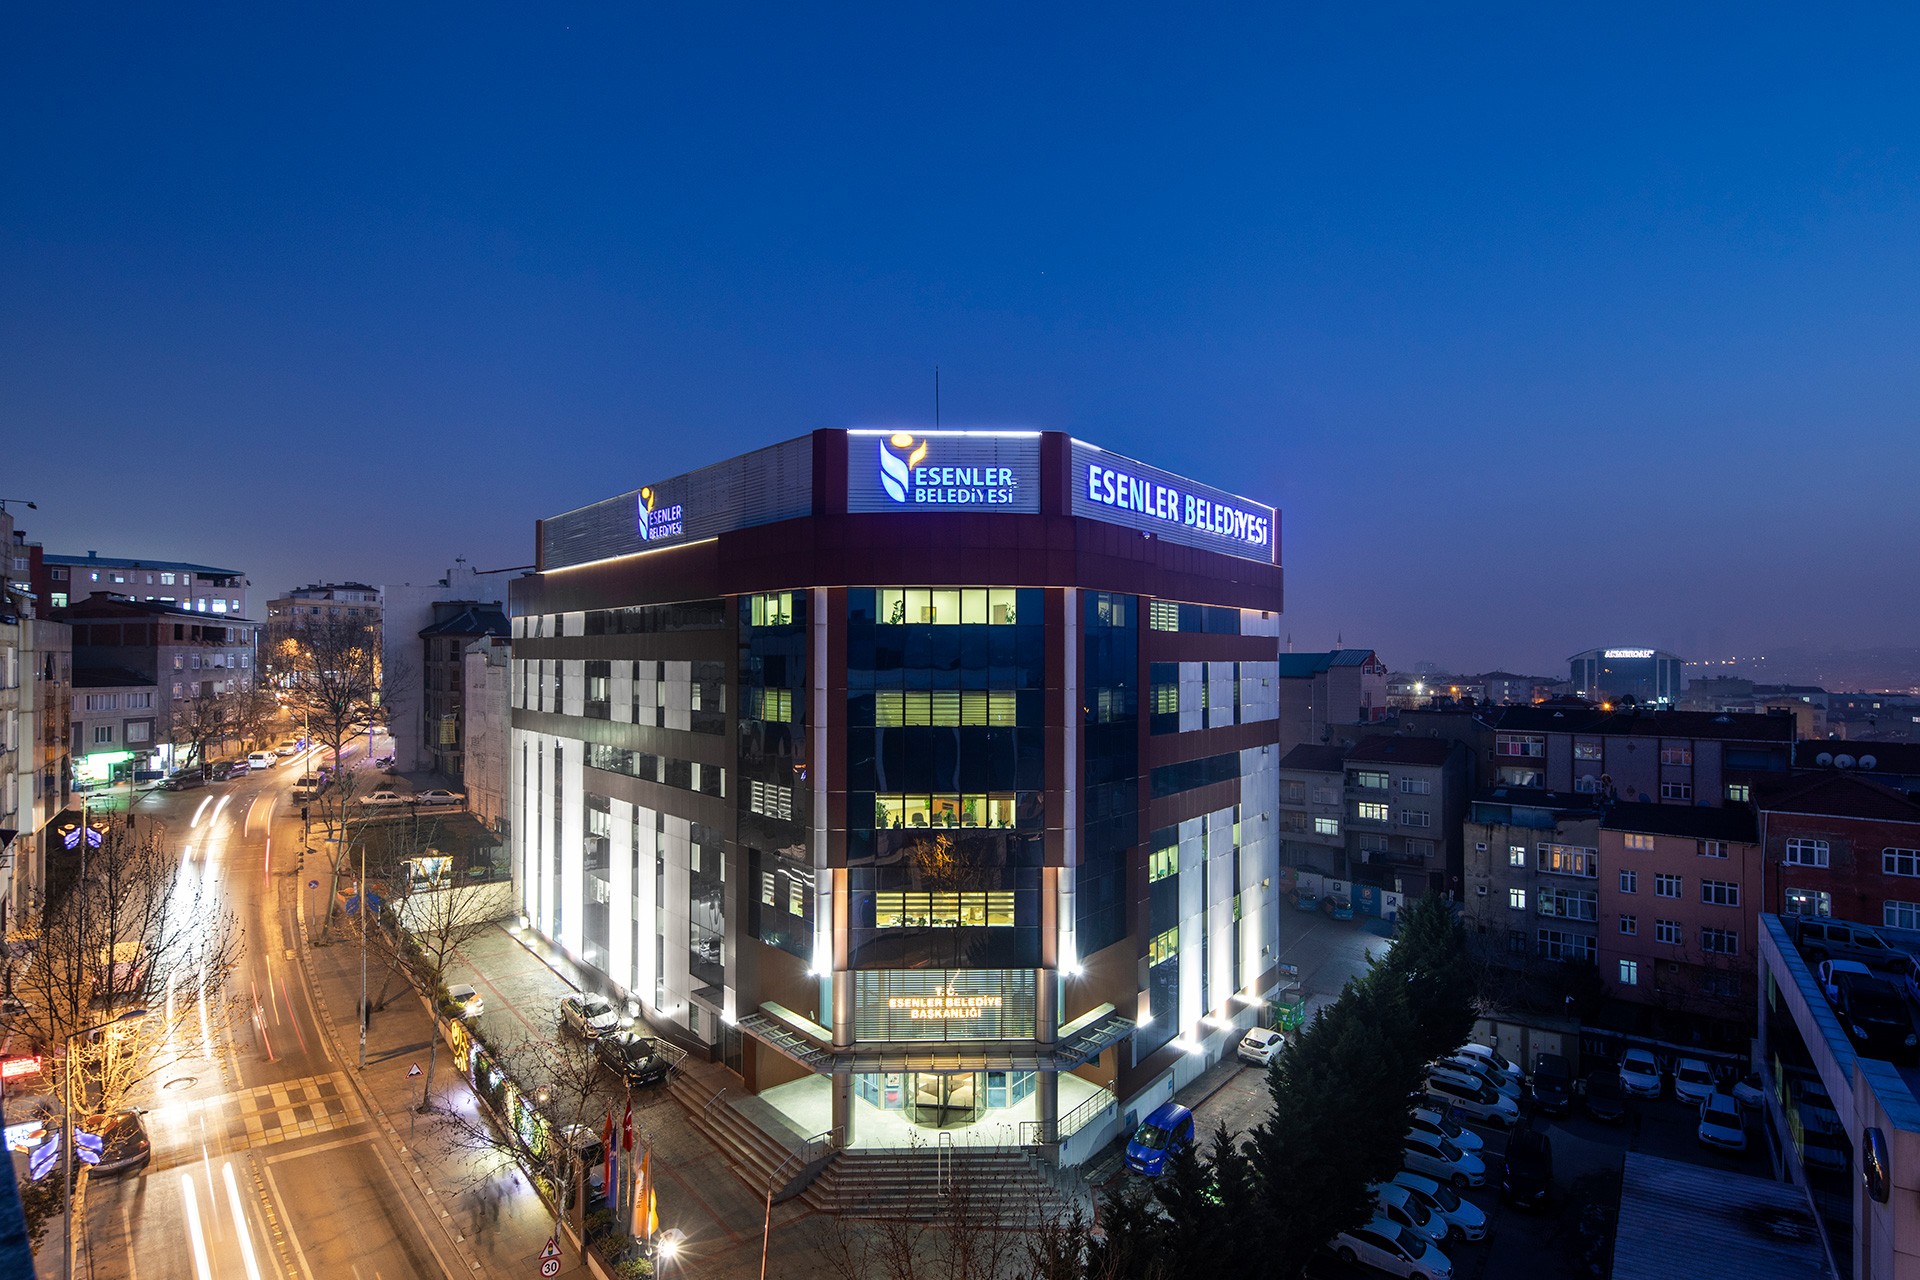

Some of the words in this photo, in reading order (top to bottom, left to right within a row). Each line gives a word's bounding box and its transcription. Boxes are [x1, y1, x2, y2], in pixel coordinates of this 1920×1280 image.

[915, 467, 1013, 486] ESENLER
[1089, 464, 1179, 522] ESENLER
[649, 504, 682, 526] ESENLER
[889, 998, 943, 1008] ESENLER
[945, 995, 1002, 1007] BELEDİYE
[911, 1007, 981, 1019] BAŞKANLIĞI
[544, 1261, 557, 1274] 30
